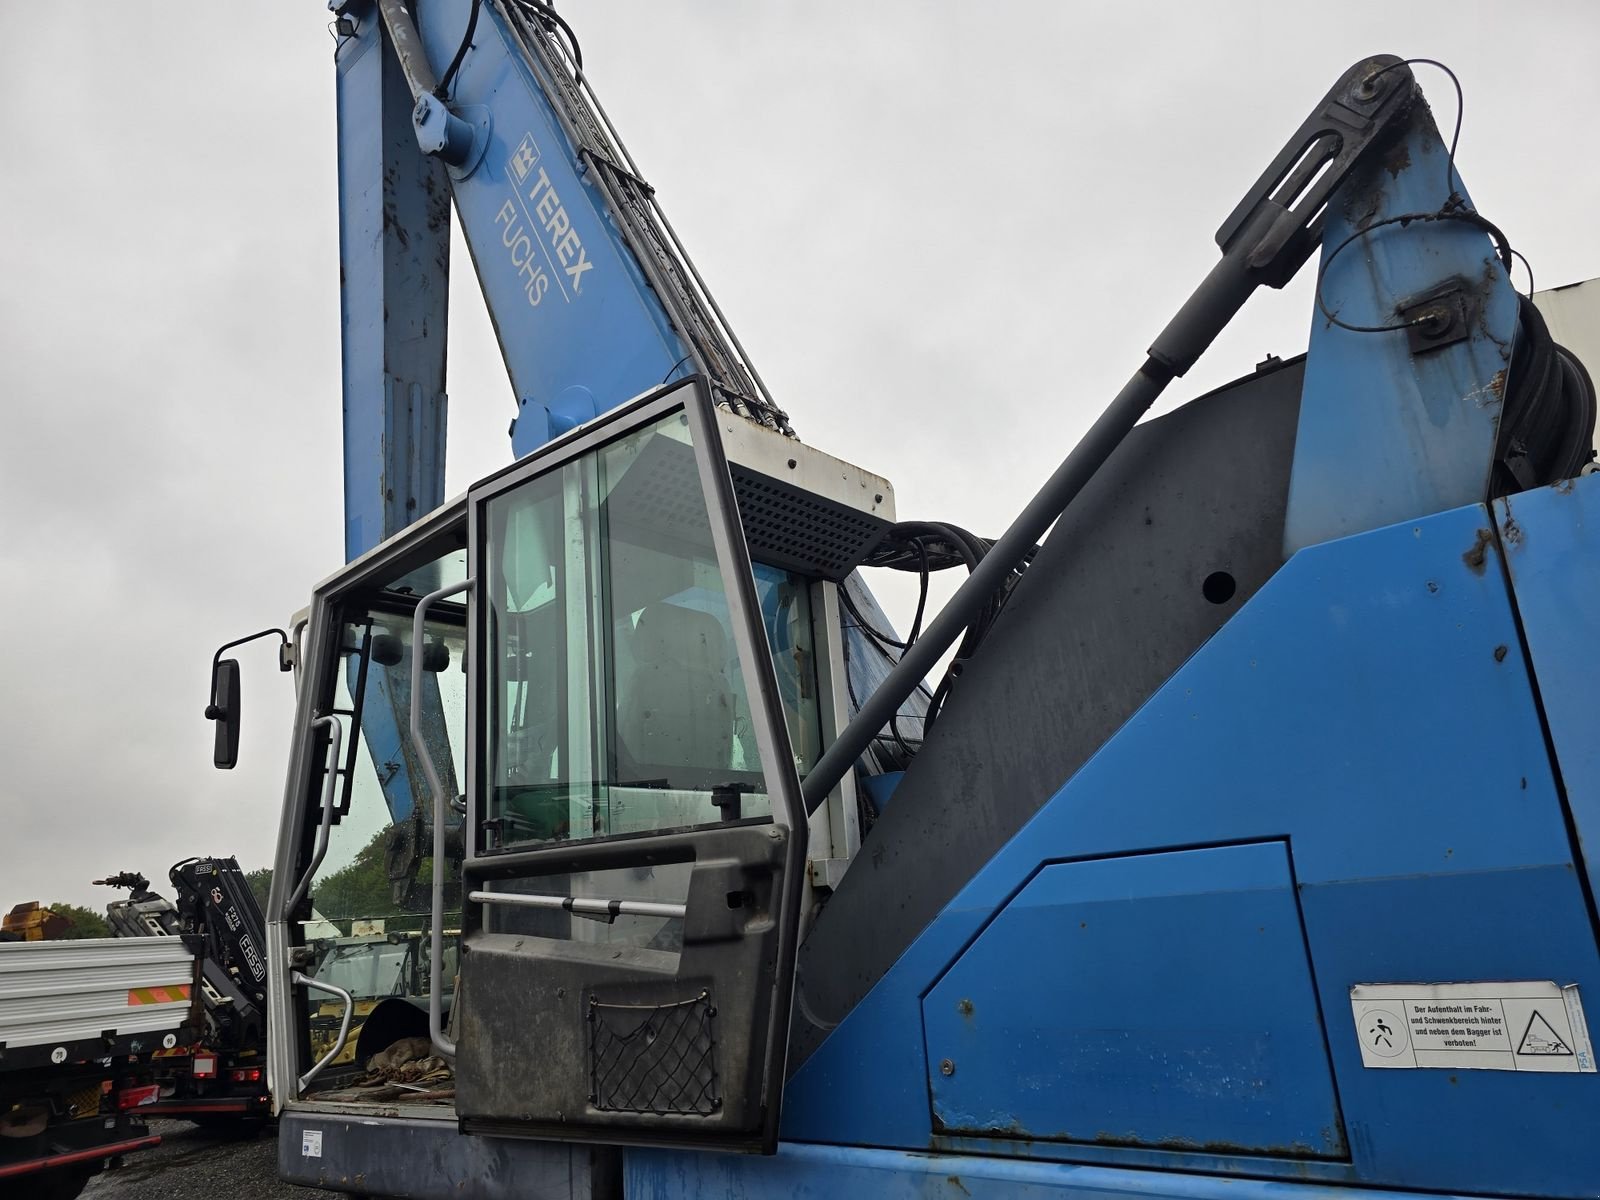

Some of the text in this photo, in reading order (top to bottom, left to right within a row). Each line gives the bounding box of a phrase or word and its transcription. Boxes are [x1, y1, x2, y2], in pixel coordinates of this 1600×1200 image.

[529, 167, 593, 291] TEREX
[494, 199, 549, 307] FUCHS
[241, 938, 264, 978] FASSI
[1414, 1005, 1493, 1013] Der Aufenthalt im Fahr-
[1466, 1028, 1491, 1037] Bagger
[1578, 1051, 1589, 1069] PSA
